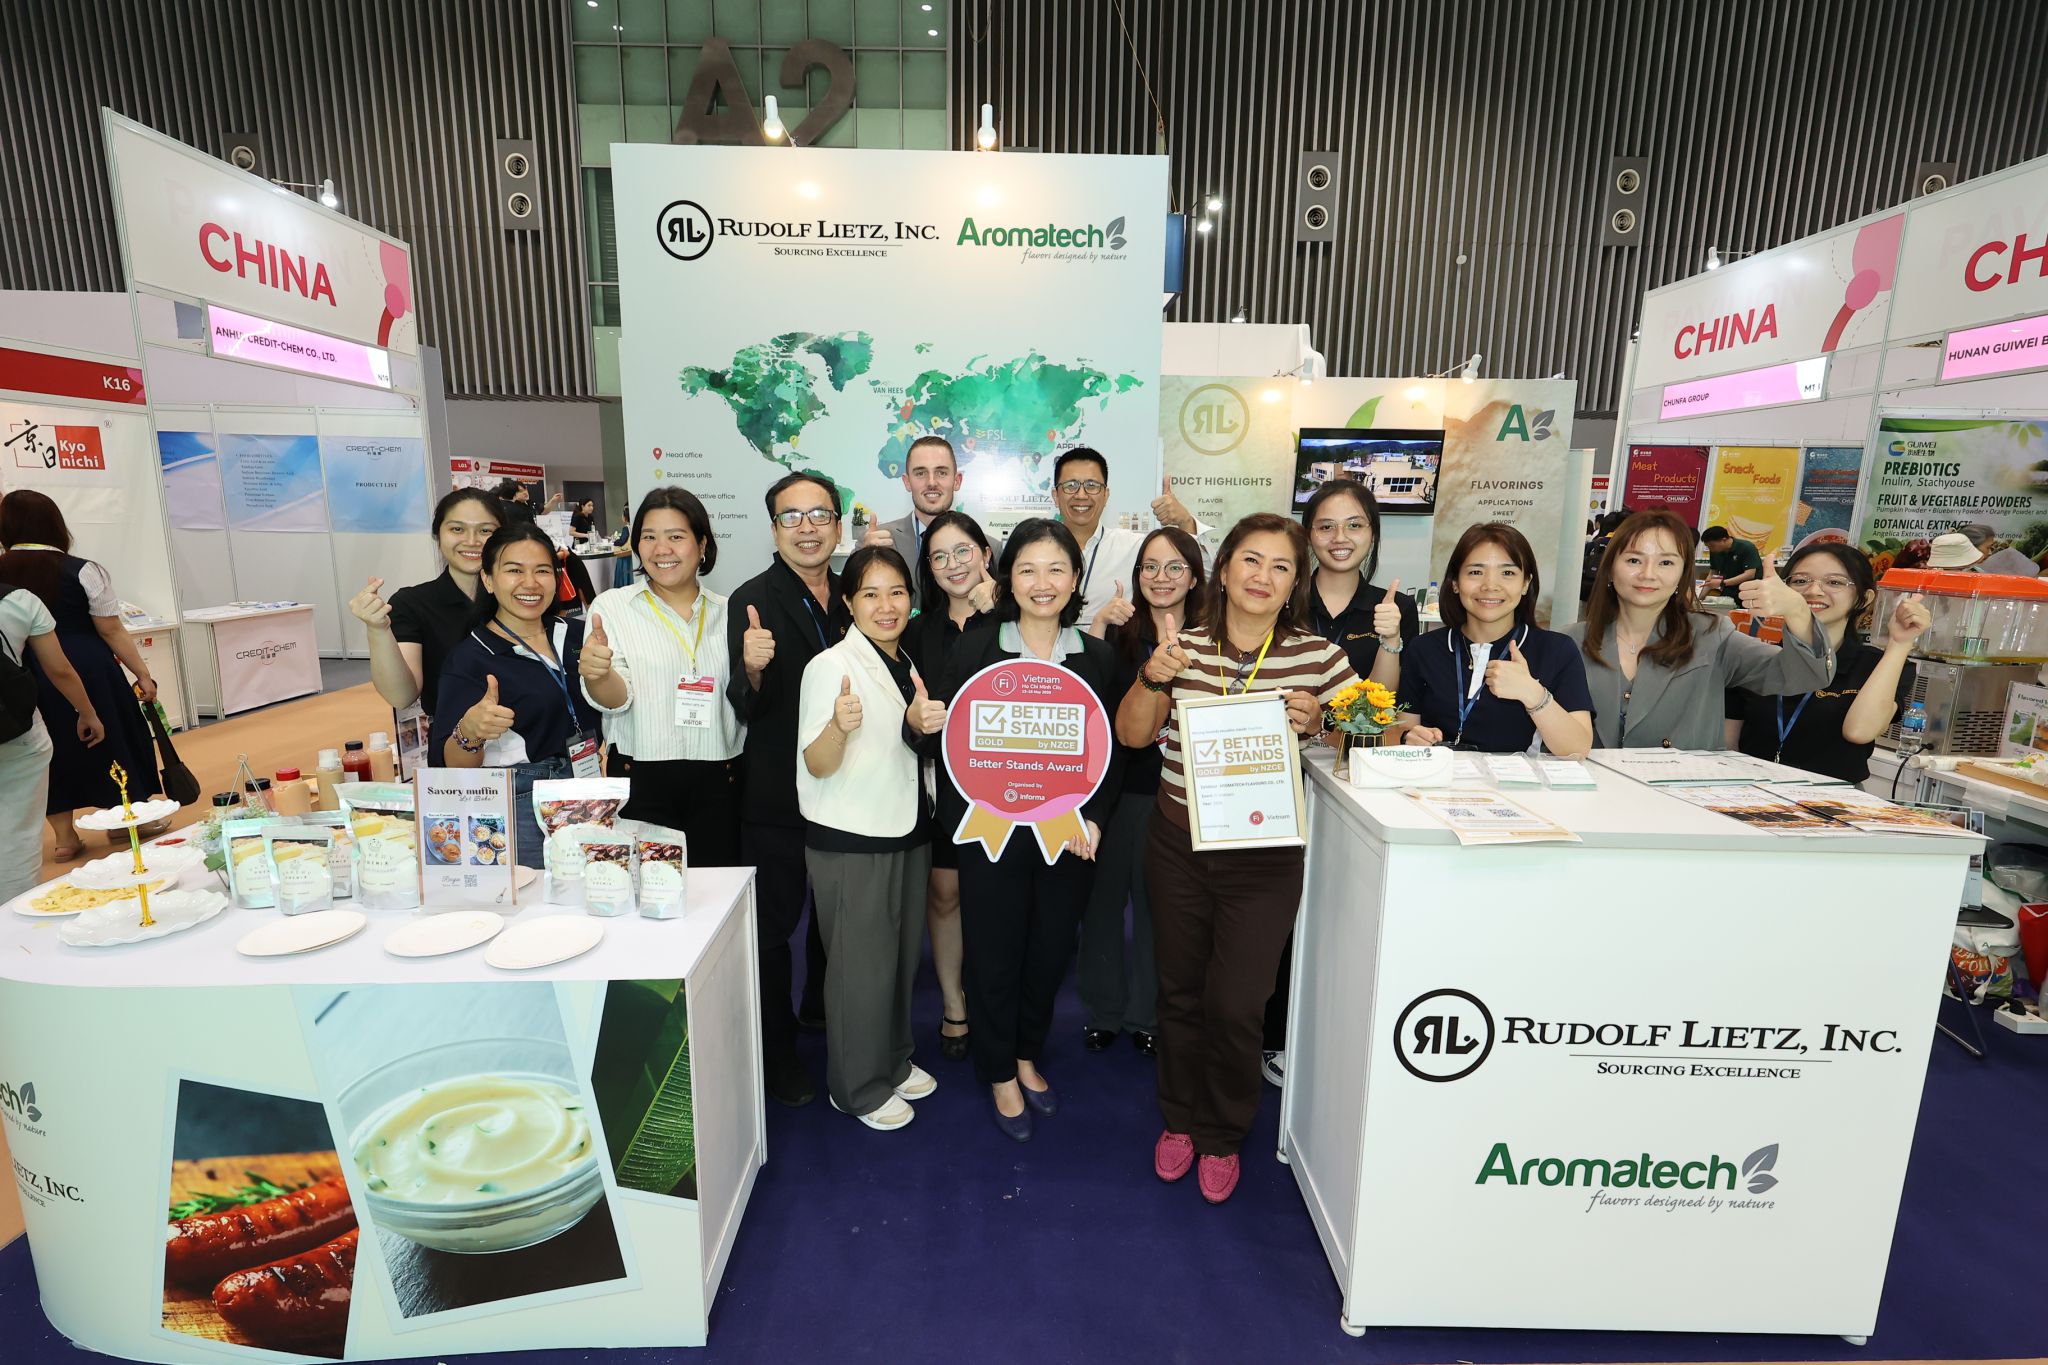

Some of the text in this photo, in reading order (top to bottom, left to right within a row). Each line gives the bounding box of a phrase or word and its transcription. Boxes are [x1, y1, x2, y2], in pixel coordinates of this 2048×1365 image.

[675, 36, 857, 147] A2
[717, 218, 812, 238] RUDOLF
[817, 220, 889, 241] LIETZ,
[895, 221, 940, 240] INC.
[956, 217, 1104, 248] Aromatech
[774, 247, 888, 258] SOURCING EXCELLENCE
[1021, 248, 1128, 265] flavors designed by nature
[198, 221, 338, 308] CHINA
[1674, 302, 1779, 360] CHINA
[215, 326, 246, 342] ANHU
[247, 335, 305, 356] CREDIT-CHEM
[1948, 345, 1990, 361] HUNAN
[1993, 336, 2039, 354] GUIWEI
[102, 375, 131, 392] K16
[1663, 392, 1710, 407] CHUNFA GROUP
[1495, 404, 1530, 442] A
[59, 439, 86, 455] Kyo
[61, 455, 100, 468] nichi
[1632, 460, 1658, 471] Meat
[1883, 461, 1961, 477] PREBIOTICS
[1171, 476, 1272, 487] DUCT HIGHLIGHTS
[1471, 480, 1544, 490] FLAVORINGS
[1653, 473, 1697, 483] Products
[1881, 476, 1975, 490] Inulin, Stachyouse
[1877, 493, 2032, 509] FRUIT & VEGETABLE POWDERS
[1876, 506, 1903, 514] Pumpkin
[1873, 518, 1924, 530] BOTANICAL
[1872, 530, 1900, 539] Angelica
[235, 641, 297, 660] CREDIT-CHEM
[1021, 674, 1061, 684] Vietnam
[1011, 704, 1079, 720] BETTER
[1011, 720, 1080, 737] STANDS
[977, 738, 1076, 750] GOLD by NZCE
[1223, 734, 1283, 750] BETTER
[1224, 748, 1285, 764] STANDS
[1371, 747, 1424, 758] Aromatech
[969, 758, 1084, 773] Better Stands Award
[1197, 768, 1220, 776] GOLD
[427, 786, 499, 796] Savory muffin
[1019, 793, 1046, 801] informa
[1501, 1016, 1671, 1048] RUDOLF
[1678, 1020, 1809, 1054] LIETZ,
[1819, 1023, 1903, 1053] INC.
[1596, 1061, 1801, 1079] SOURCING EXCELLENCE
[1474, 1142, 1737, 1191] Aromatech
[44, 1175, 85, 1203] INC.
[1585, 1188, 1776, 1214] flavors designed by nature
